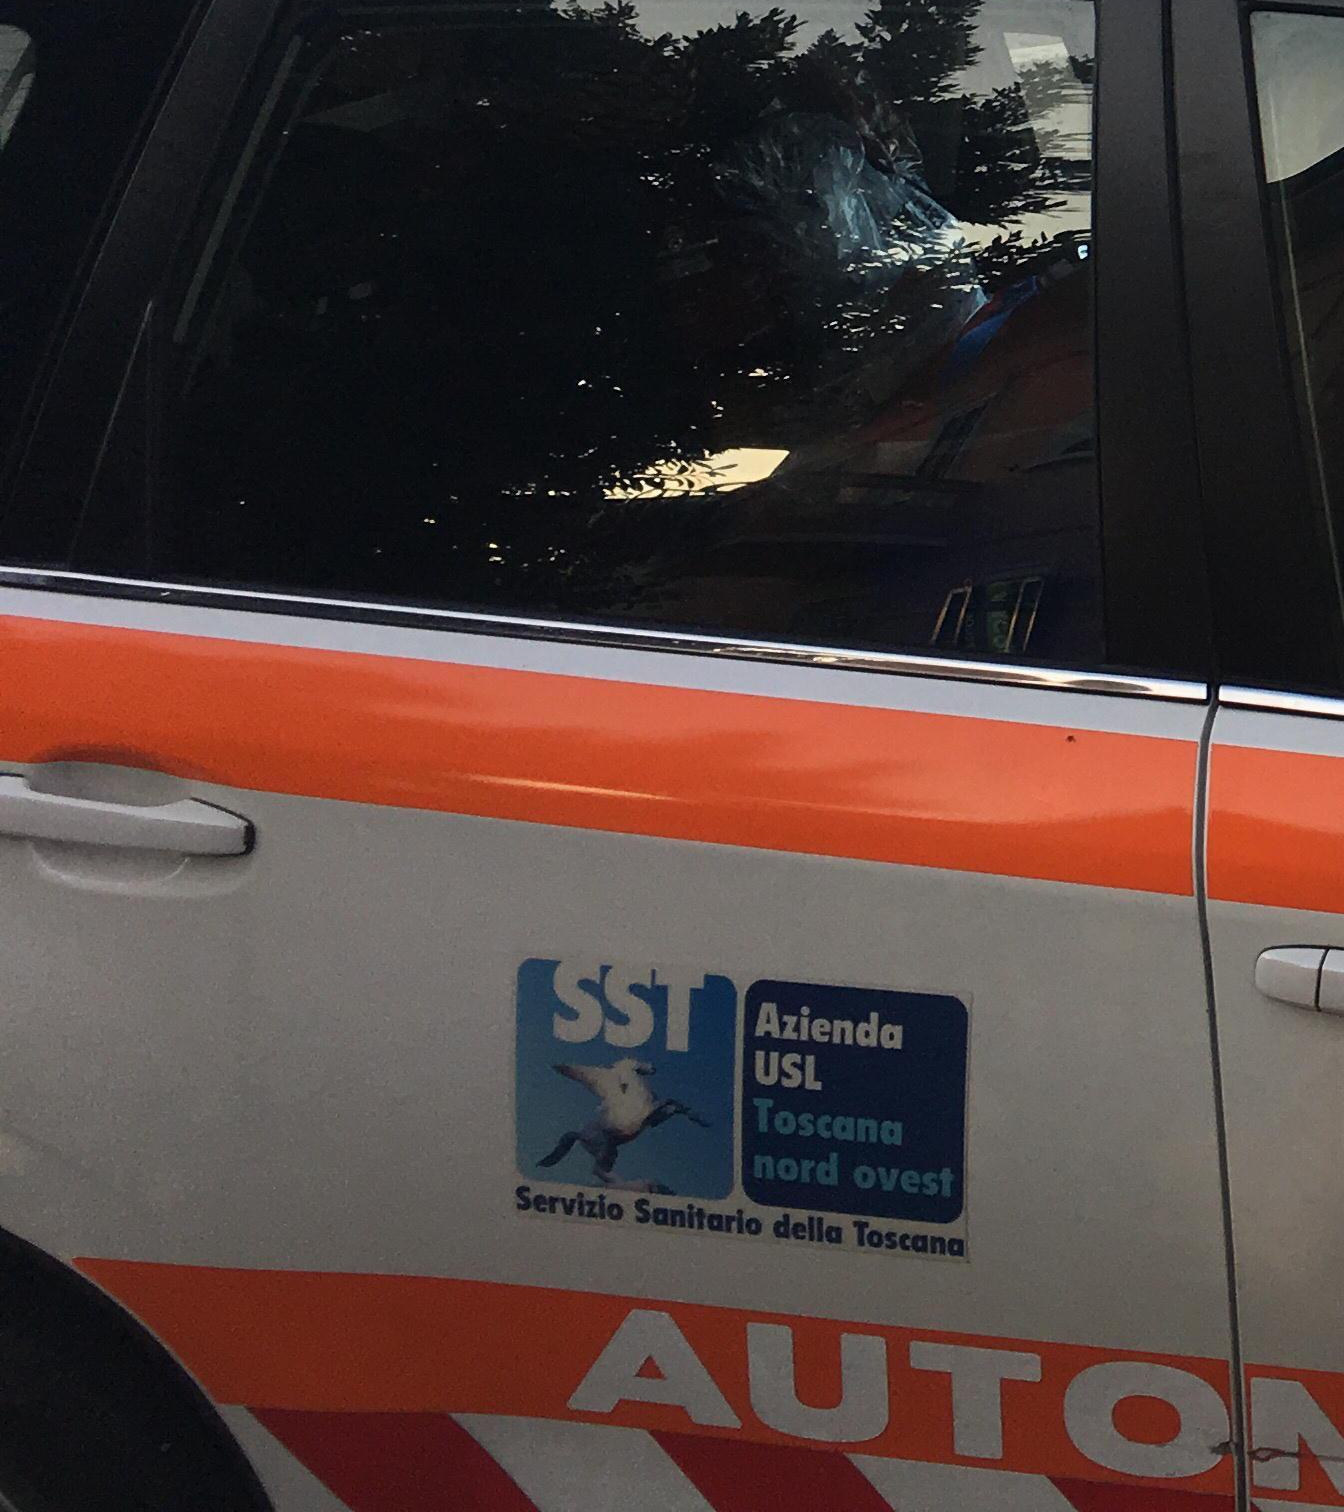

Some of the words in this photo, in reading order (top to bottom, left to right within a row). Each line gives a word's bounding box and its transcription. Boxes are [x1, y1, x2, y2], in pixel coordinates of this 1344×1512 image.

[553, 957, 706, 1052] SST
[754, 1002, 903, 1051] Azienda
[754, 1051, 823, 1091] USL
[752, 1097, 903, 1146] Toscana
[752, 1152, 839, 1186] nord
[853, 1167, 957, 1198] ovest
[515, 1186, 624, 1221] Servizio
[634, 1199, 763, 1237] Sanitario
[772, 1211, 843, 1245] della
[852, 1221, 965, 1258] Toscana
